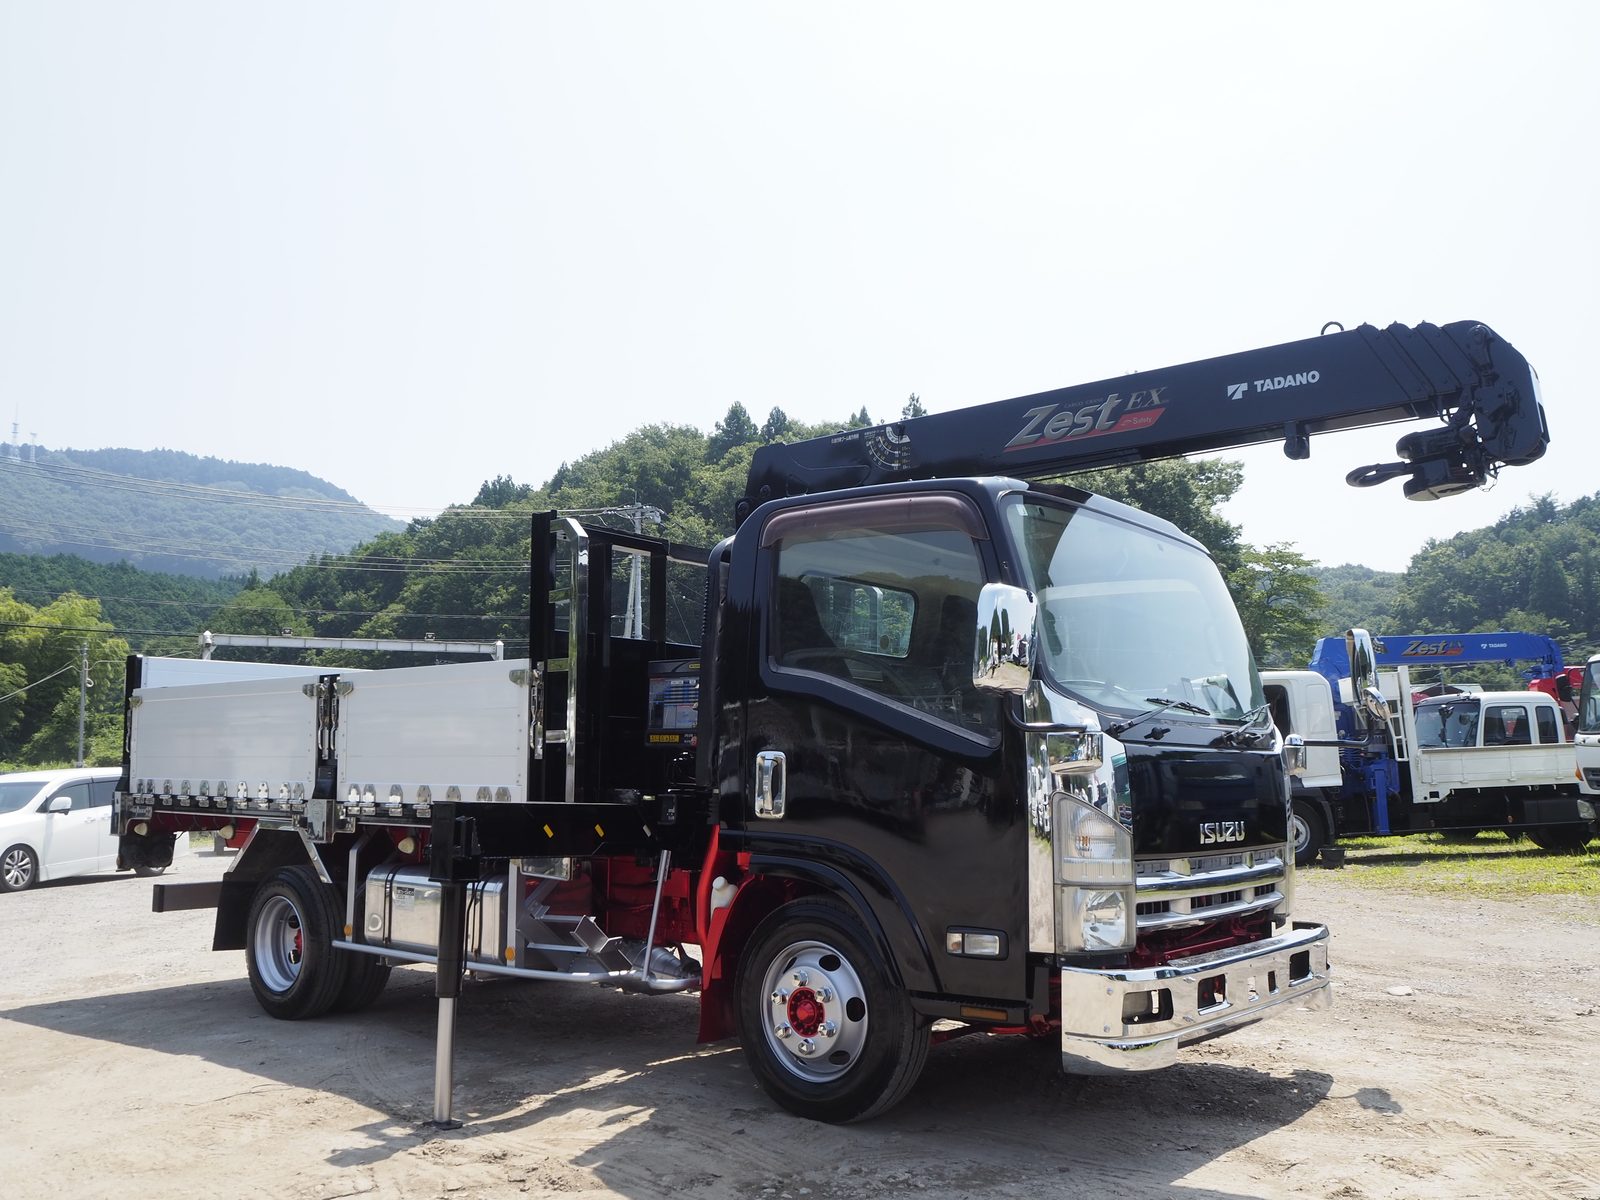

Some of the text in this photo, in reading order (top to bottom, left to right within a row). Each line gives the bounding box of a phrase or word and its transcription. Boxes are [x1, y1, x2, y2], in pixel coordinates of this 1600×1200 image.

[1254, 370, 1320, 392] TADANO
[1003, 386, 1167, 448] Zest EX
[1401, 640, 1447, 656] Zest
[1200, 821, 1245, 844] ISUZU
